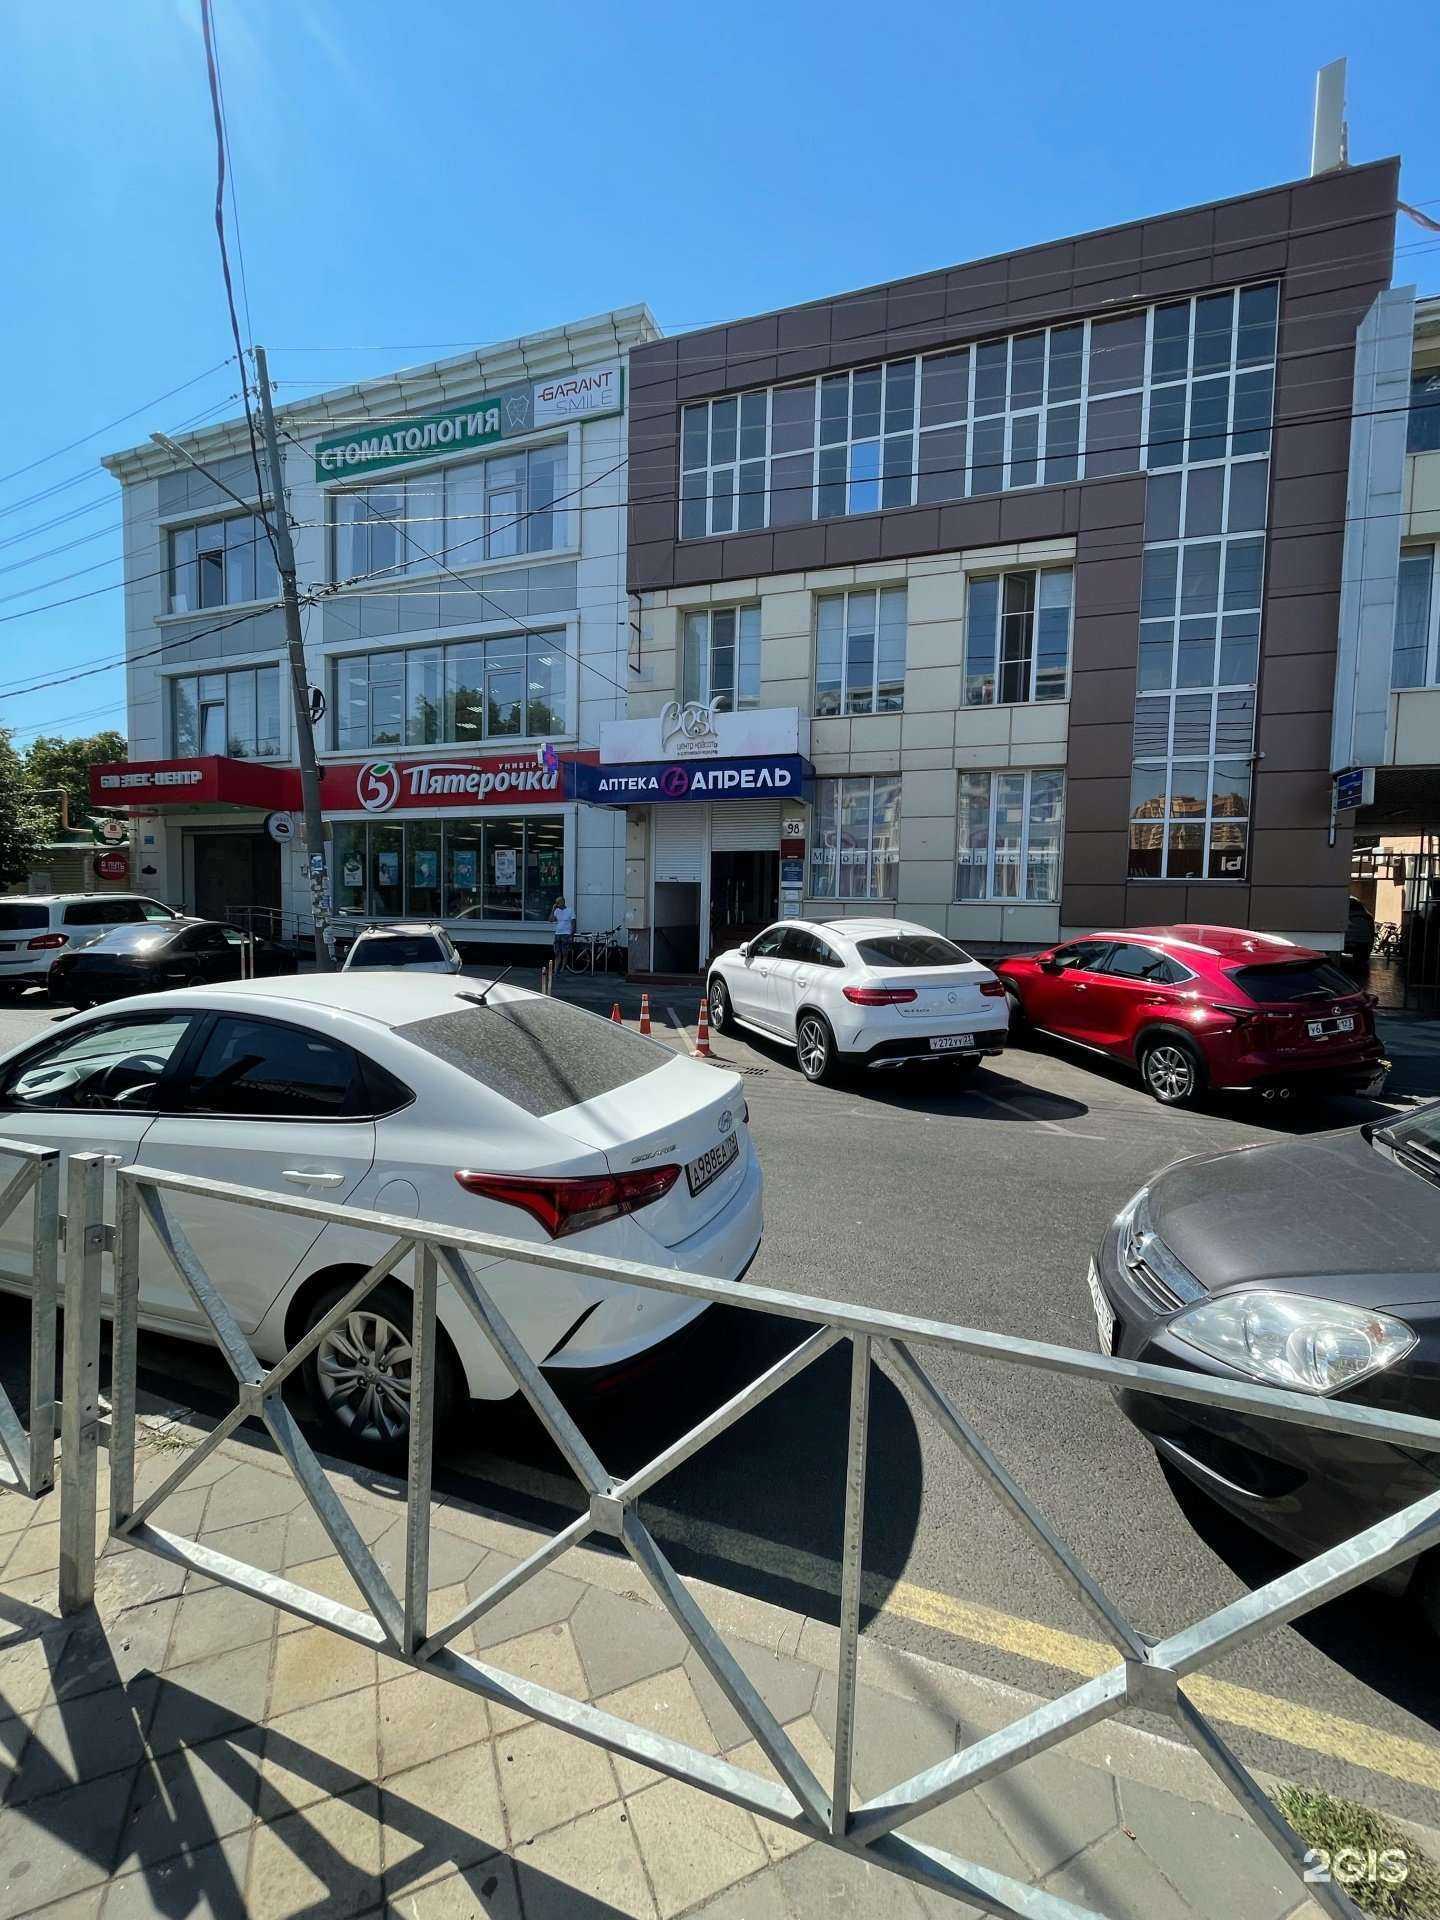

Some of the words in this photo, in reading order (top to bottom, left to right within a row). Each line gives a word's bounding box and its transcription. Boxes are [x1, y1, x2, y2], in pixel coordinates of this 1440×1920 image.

[537, 372, 613, 401] GARANT
[556, 389, 613, 415] SMILE
[321, 408, 499, 470] СТОМАТОЛОГИЯ
[598, 777, 659, 791] АПТЕКА
[690, 767, 792, 790] АПРЕЛЬ
[787, 823, 800, 834] 98
[693, 1144, 728, 1186] А988ЕА
